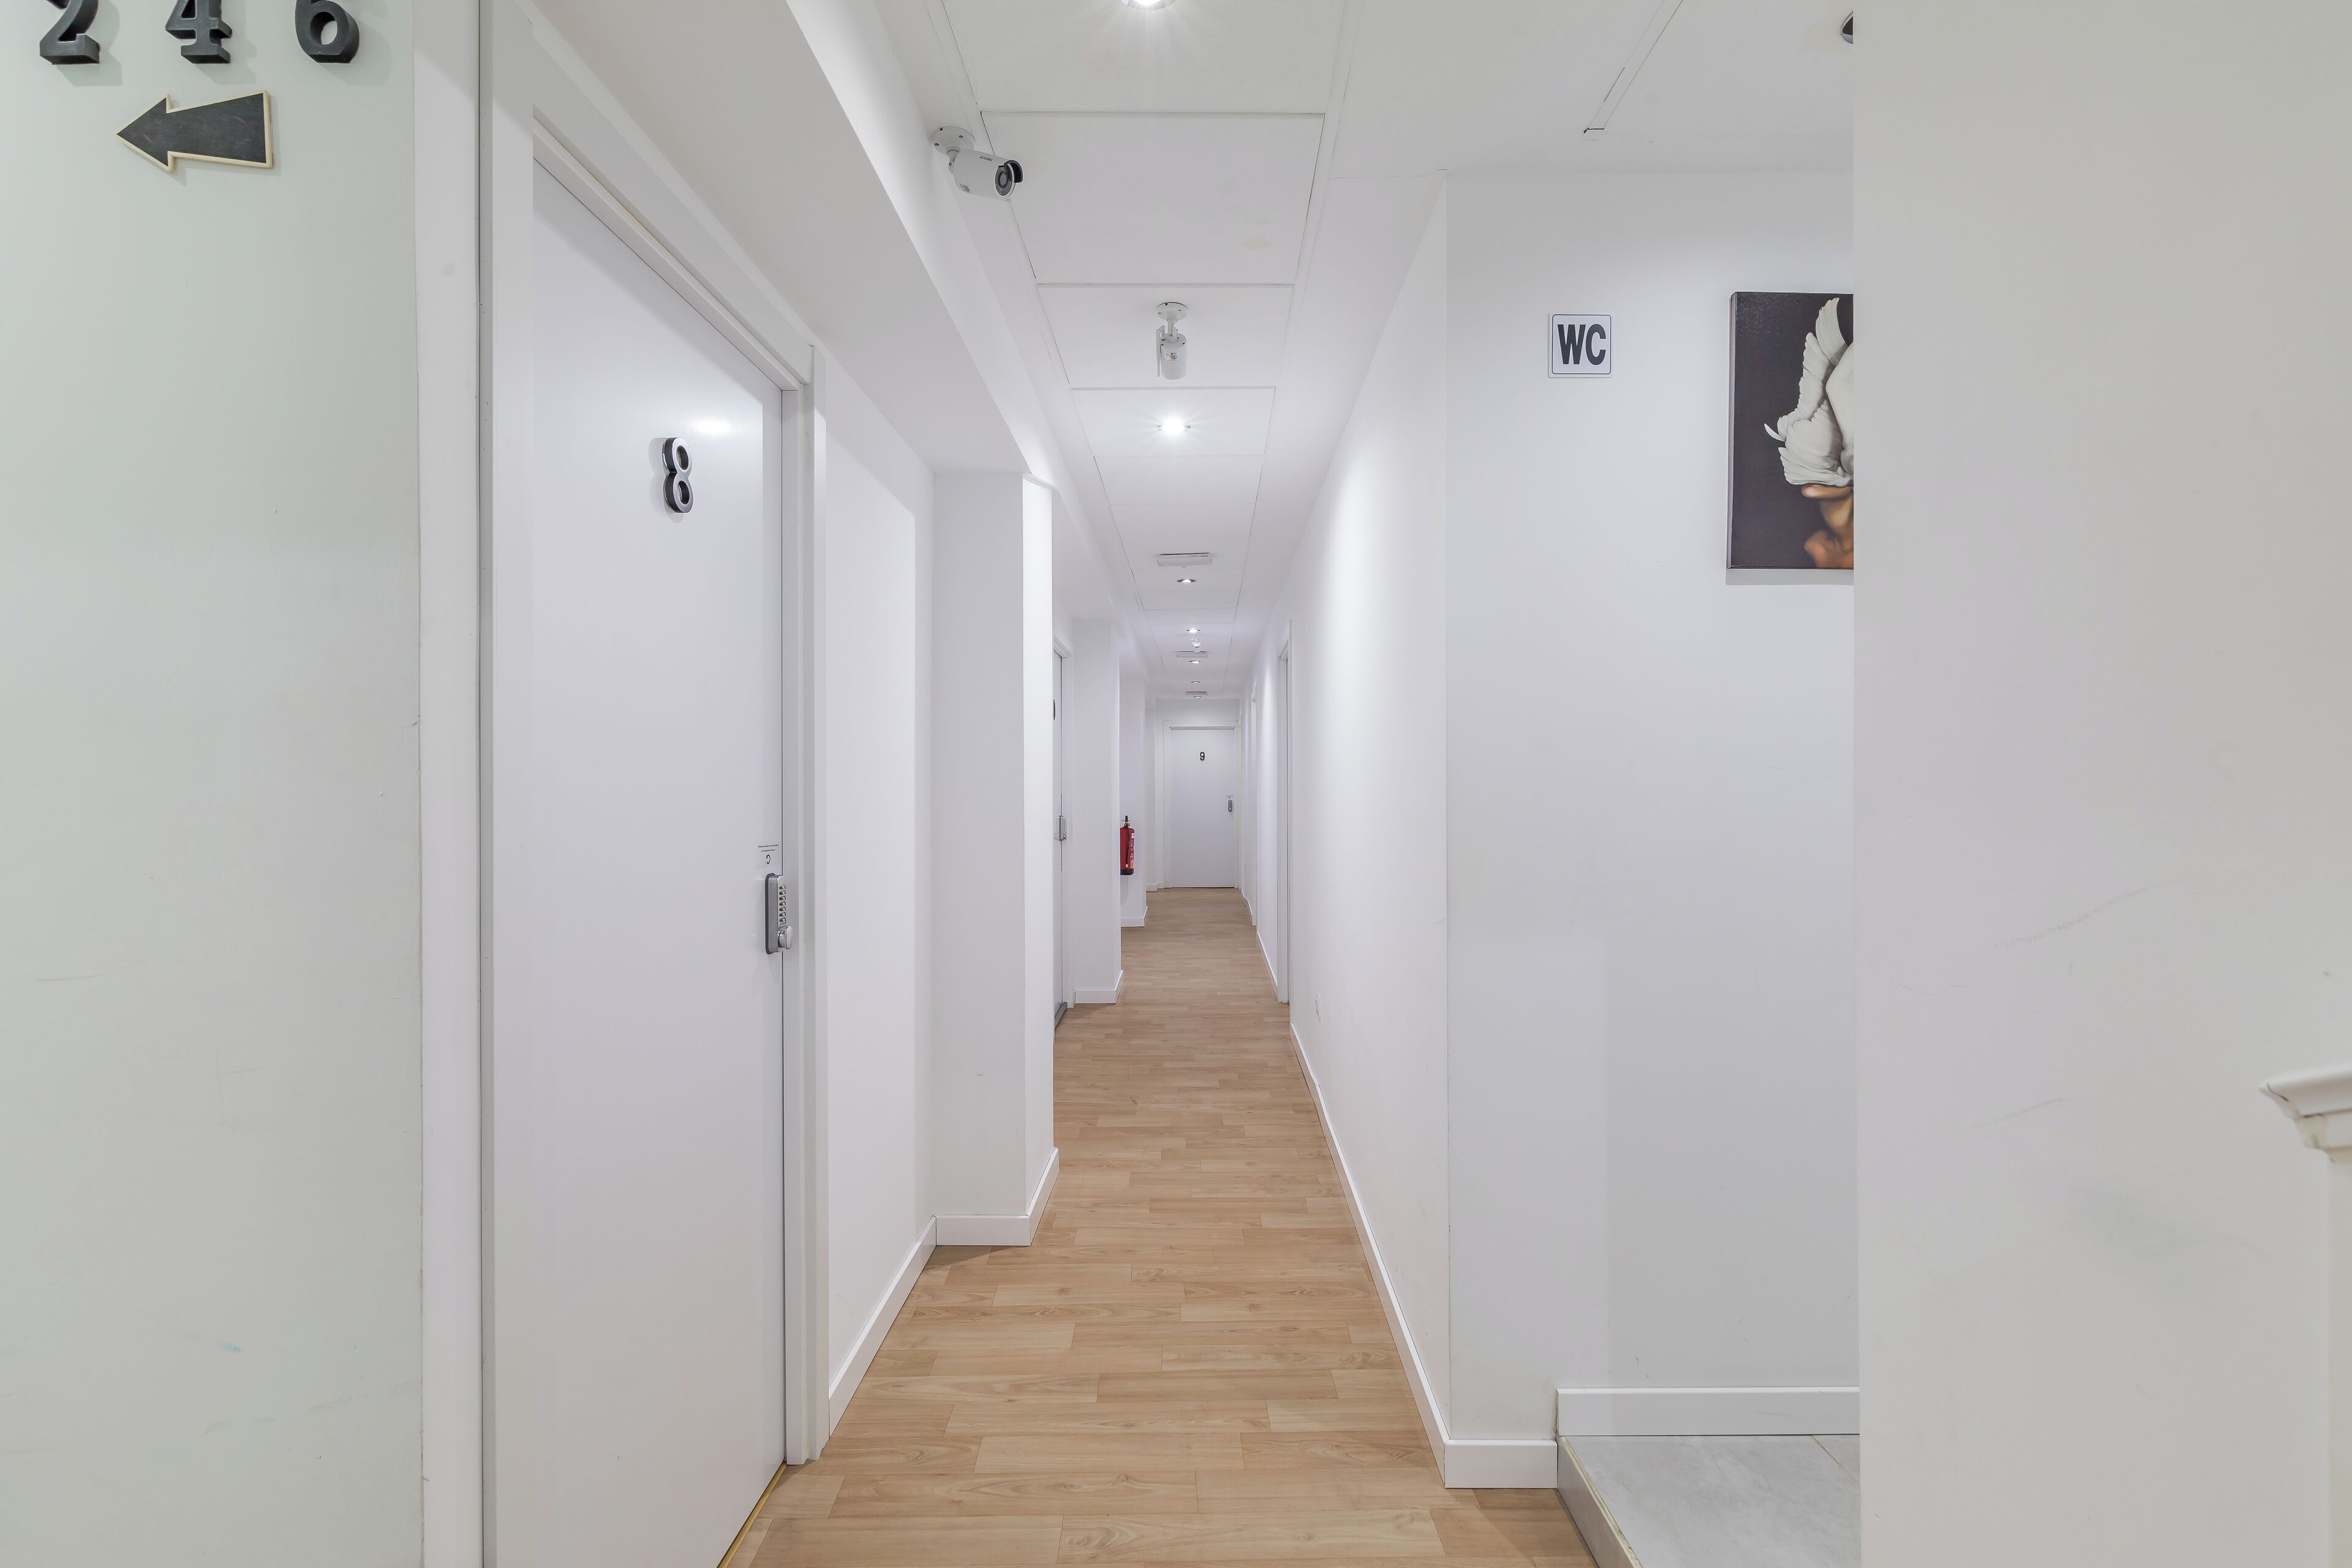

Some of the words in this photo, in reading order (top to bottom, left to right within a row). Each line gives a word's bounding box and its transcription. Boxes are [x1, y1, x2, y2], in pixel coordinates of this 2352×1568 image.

[40, 0, 99, 64] 2
[165, 0, 232, 63] 4
[295, 0, 360, 63] 6
[1557, 323, 1606, 365] WC
[662, 437, 693, 513] 8
[1200, 752, 1205, 760] 9
